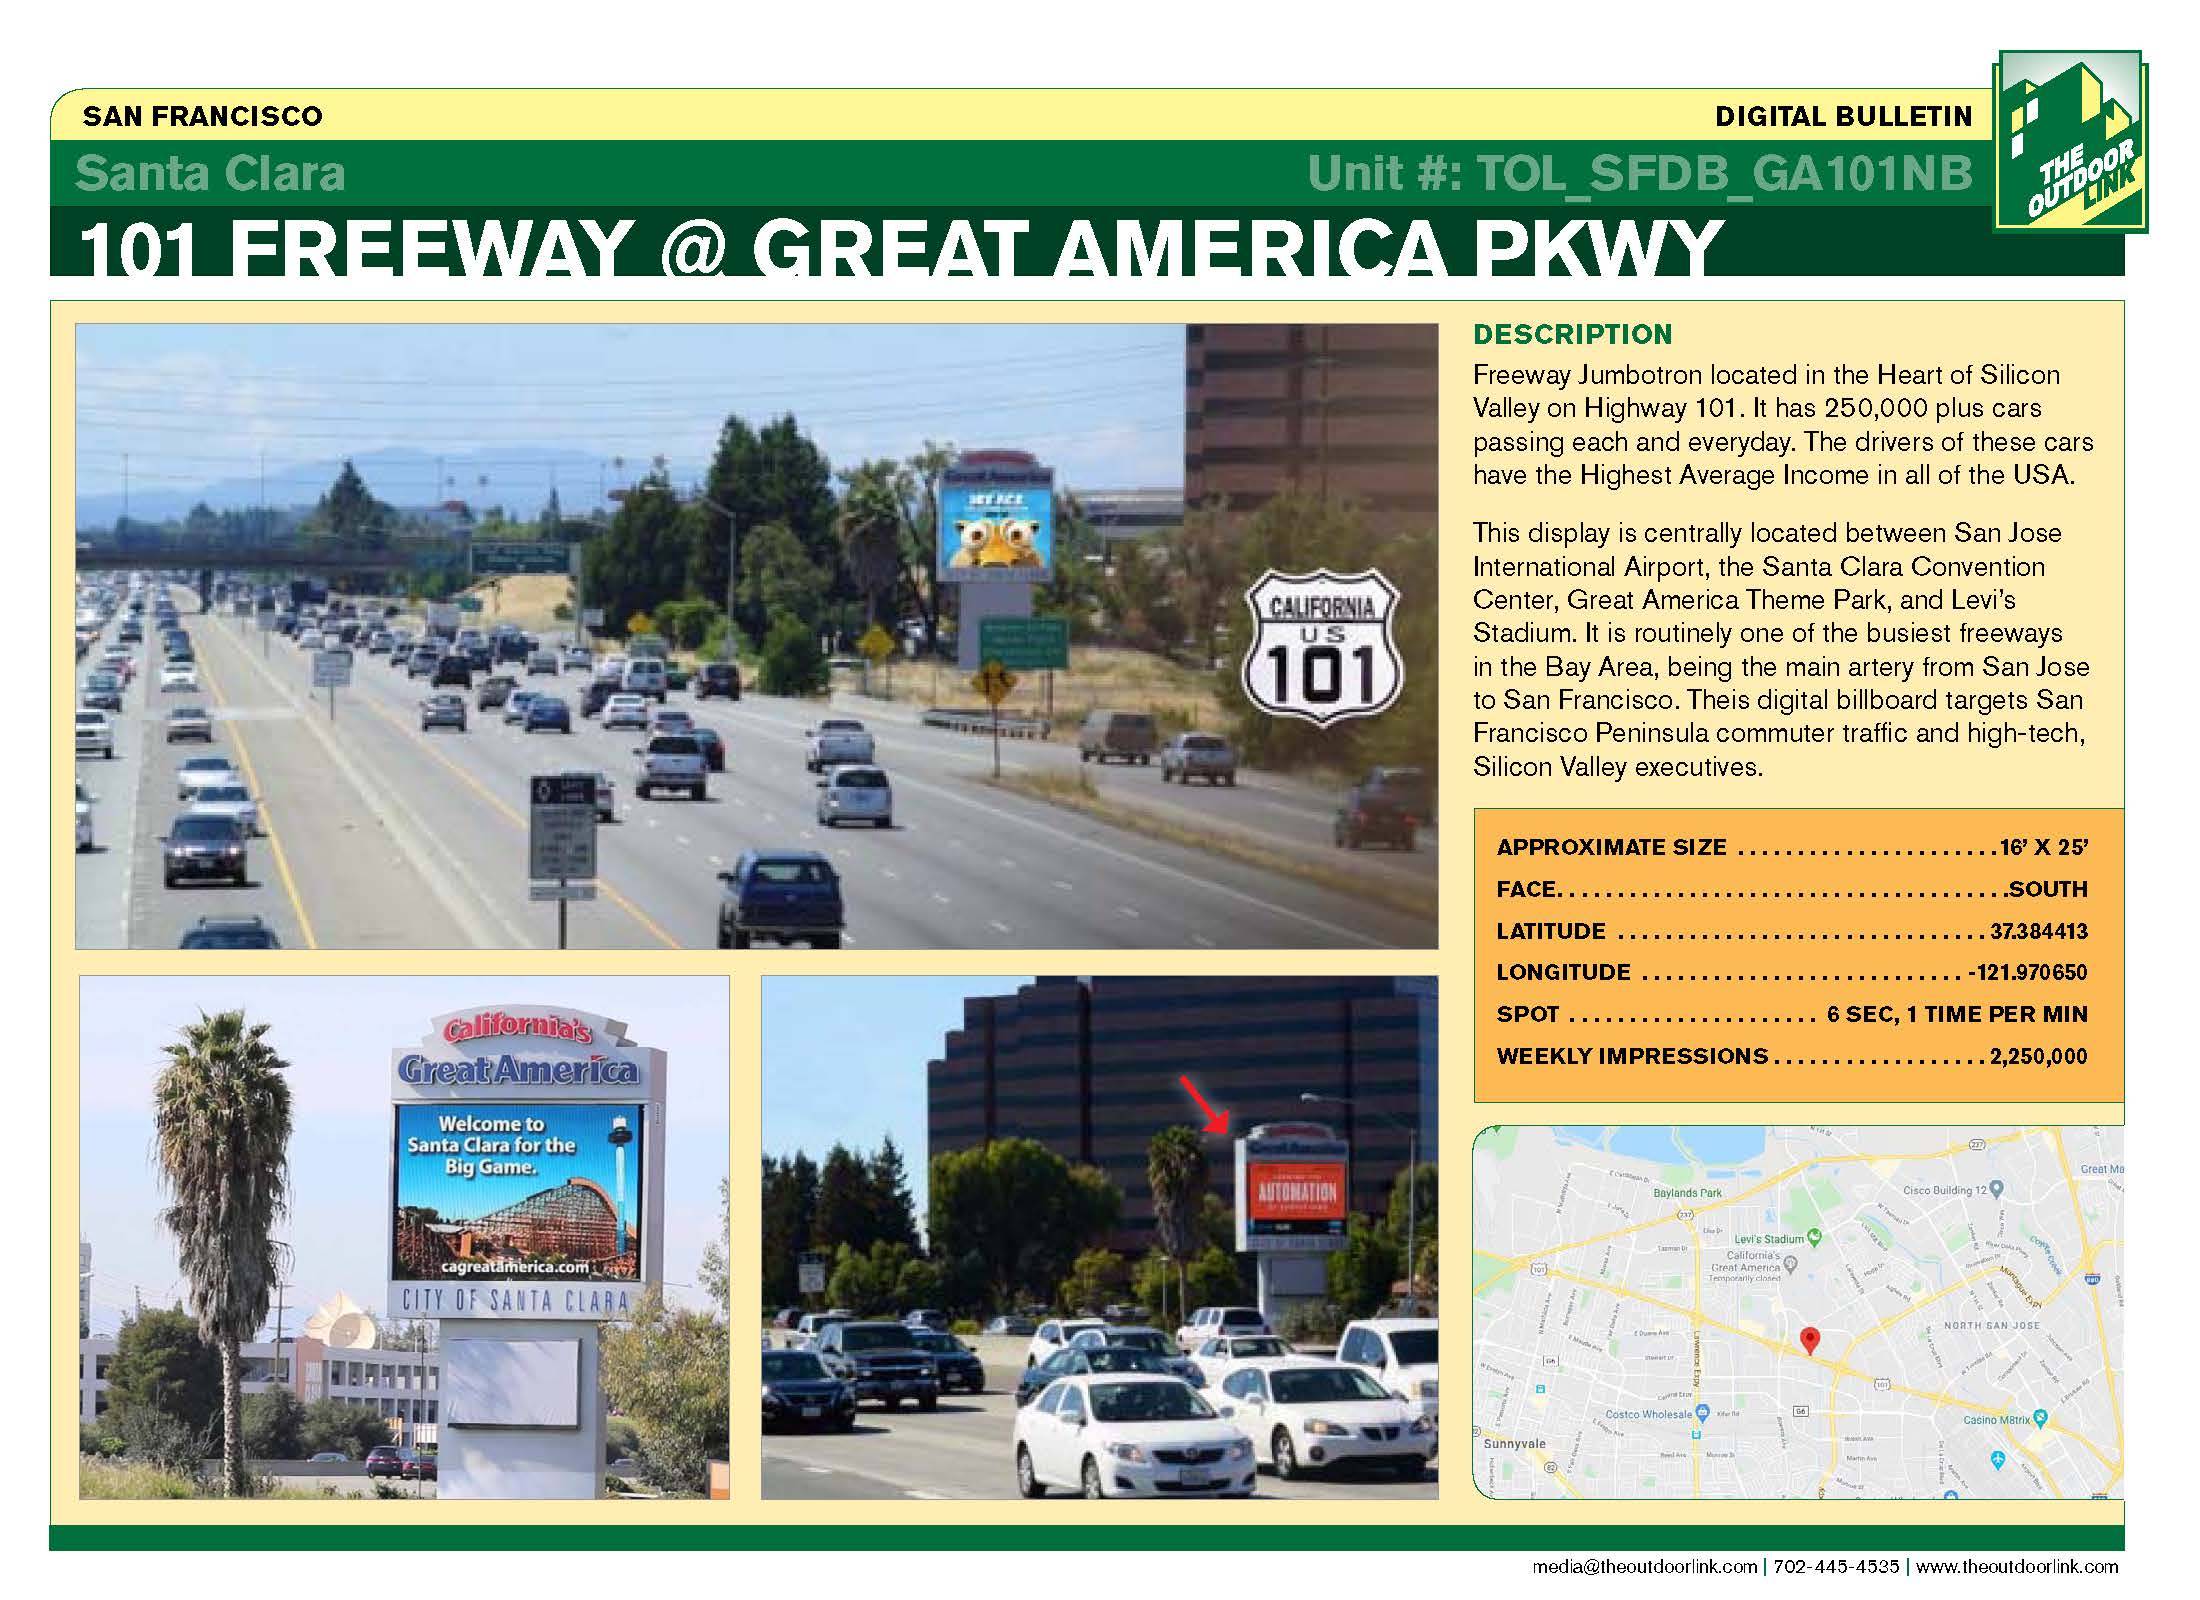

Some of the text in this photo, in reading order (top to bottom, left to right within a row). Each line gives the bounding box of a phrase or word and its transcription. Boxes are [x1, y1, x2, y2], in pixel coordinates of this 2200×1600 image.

[83, 106, 322, 126] SAN FRANCISCO
[1717, 106, 1971, 126] DIGITAL BULLETIN
[75, 154, 344, 191] Santa Clara
[2040, 143, 2084, 186] THE
[1310, 155, 1403, 191] Unit
[1477, 154, 1972, 202] TOL_SFDB_GA101NB
[2028, 138, 2135, 218] OUTDOOR
[2083, 163, 2136, 210] LINK
[82, 218, 1726, 274] 101 FREEWAY @ GREAT AMERICA PKWY
[1475, 324, 1671, 344] DESCRIPTION
[1475, 364, 2059, 390] Freeway Jumbotron located in the Heart of Silicon
[1473, 397, 2041, 423] Valley on Highway 101. It has 250,000 plus cars
[1475, 431, 2093, 457] passing each and everyday. The drivers of these cars
[1475, 464, 2074, 490] have the Highest Average Income in all of the USA.
[1473, 522, 2061, 548] This display is centrally located between San Jose
[1270, 595, 1375, 618] CALIFORNIA
[1266, 645, 1375, 704] 101
[1474, 756, 1762, 782] Silicon Valley executives.
[1497, 839, 1726, 855] APPROXIMATE SIZE
[2034, 839, 2051, 855] X
[1498, 881, 1555, 897] FACE
[2009, 881, 2087, 897] SOUTH
[1498, 923, 1605, 939] LATITUDE
[1991, 923, 2088, 939] 37.384413
[1498, 964, 1630, 980] LONGITUDE
[1969, 964, 2087, 980] -121.970650
[1497, 1006, 1559, 1022] SPOT
[1828, 1006, 2087, 1026] 6 SEC, 1 TIME PER MIN
[443, 1012, 593, 1045] California's
[1497, 1048, 1768, 1064] WEEKLY IMPRESSIONS
[1991, 1048, 2087, 1068] 2,250,000
[398, 1054, 640, 1085] Great America
[439, 1115, 545, 1133] Welcome to
[408, 1137, 576, 1154] Santa Clara for the
[445, 1159, 538, 1179] Big Game.
[2080, 1164, 2107, 1174] Great
[1653, 1188, 1722, 1200] Baylands Park
[1903, 1185, 1988, 1197] Cisco Building 12
[1734, 1234, 1805, 1244] Levi's Stadium
[1727, 1250, 1780, 1260] California's
[441, 1261, 590, 1277] cagreatamerica.com
[1711, 1263, 1781, 1273] Great America
[1709, 1275, 1754, 1284] Temporarily
[403, 1288, 629, 1312] CITY OF SANTA CLARA
[1944, 1321, 2041, 1330] NORTH SAN JOSE
[1605, 1409, 1693, 1419] Costco Wholesale
[1963, 1415, 2031, 1425] Casino M8trix
[1484, 1438, 1547, 1452] Sunnyvale
[1534, 1559, 1757, 1575] media@theoutdoorlink.com
[1775, 1560, 1899, 1573] 702-445-4535
[1916, 1559, 2118, 1573] www.theoutdoorlink.com
